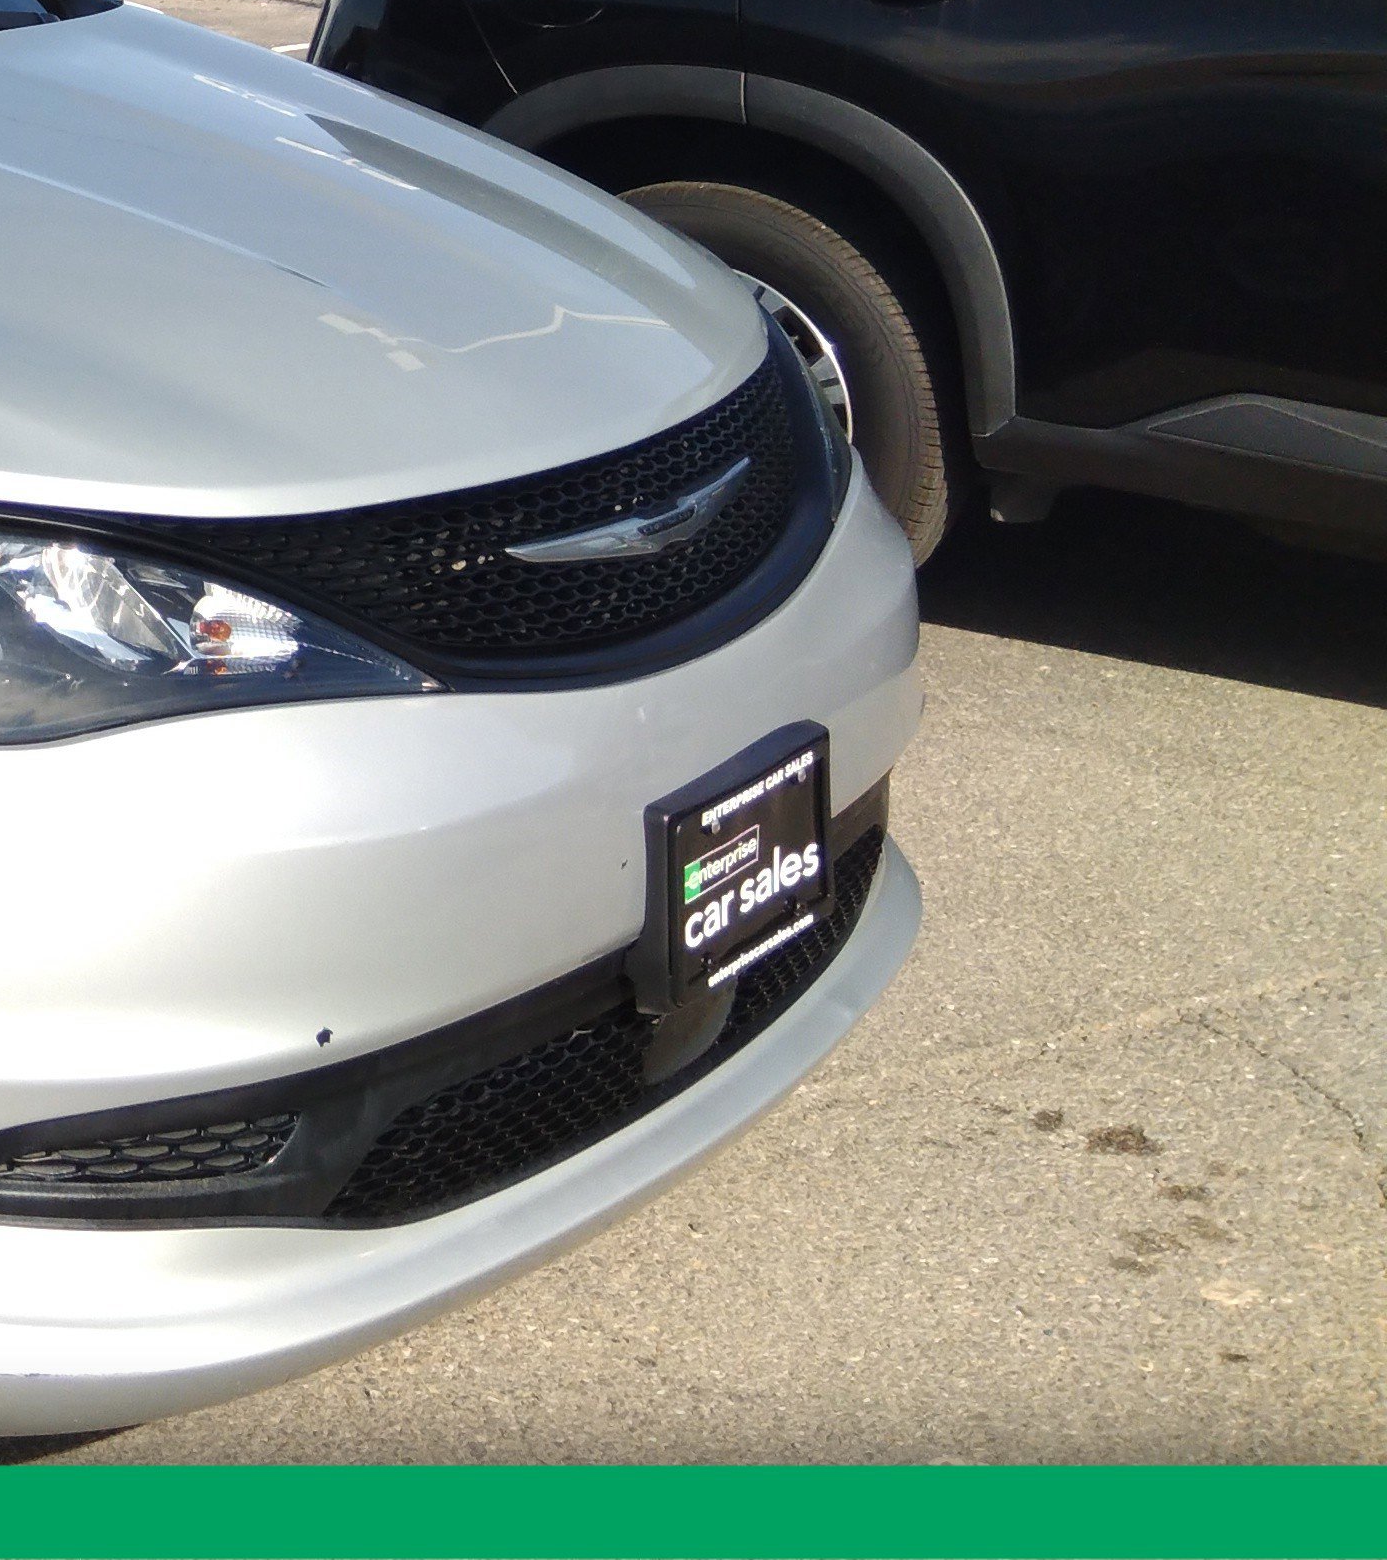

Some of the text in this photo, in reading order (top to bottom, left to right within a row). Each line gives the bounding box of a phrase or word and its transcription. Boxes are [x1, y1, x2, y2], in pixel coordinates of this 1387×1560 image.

[702, 750, 814, 826] ENTERPRISE CAR SALES
[685, 843, 820, 948] car sales
[686, 838, 757, 889] enterprise
